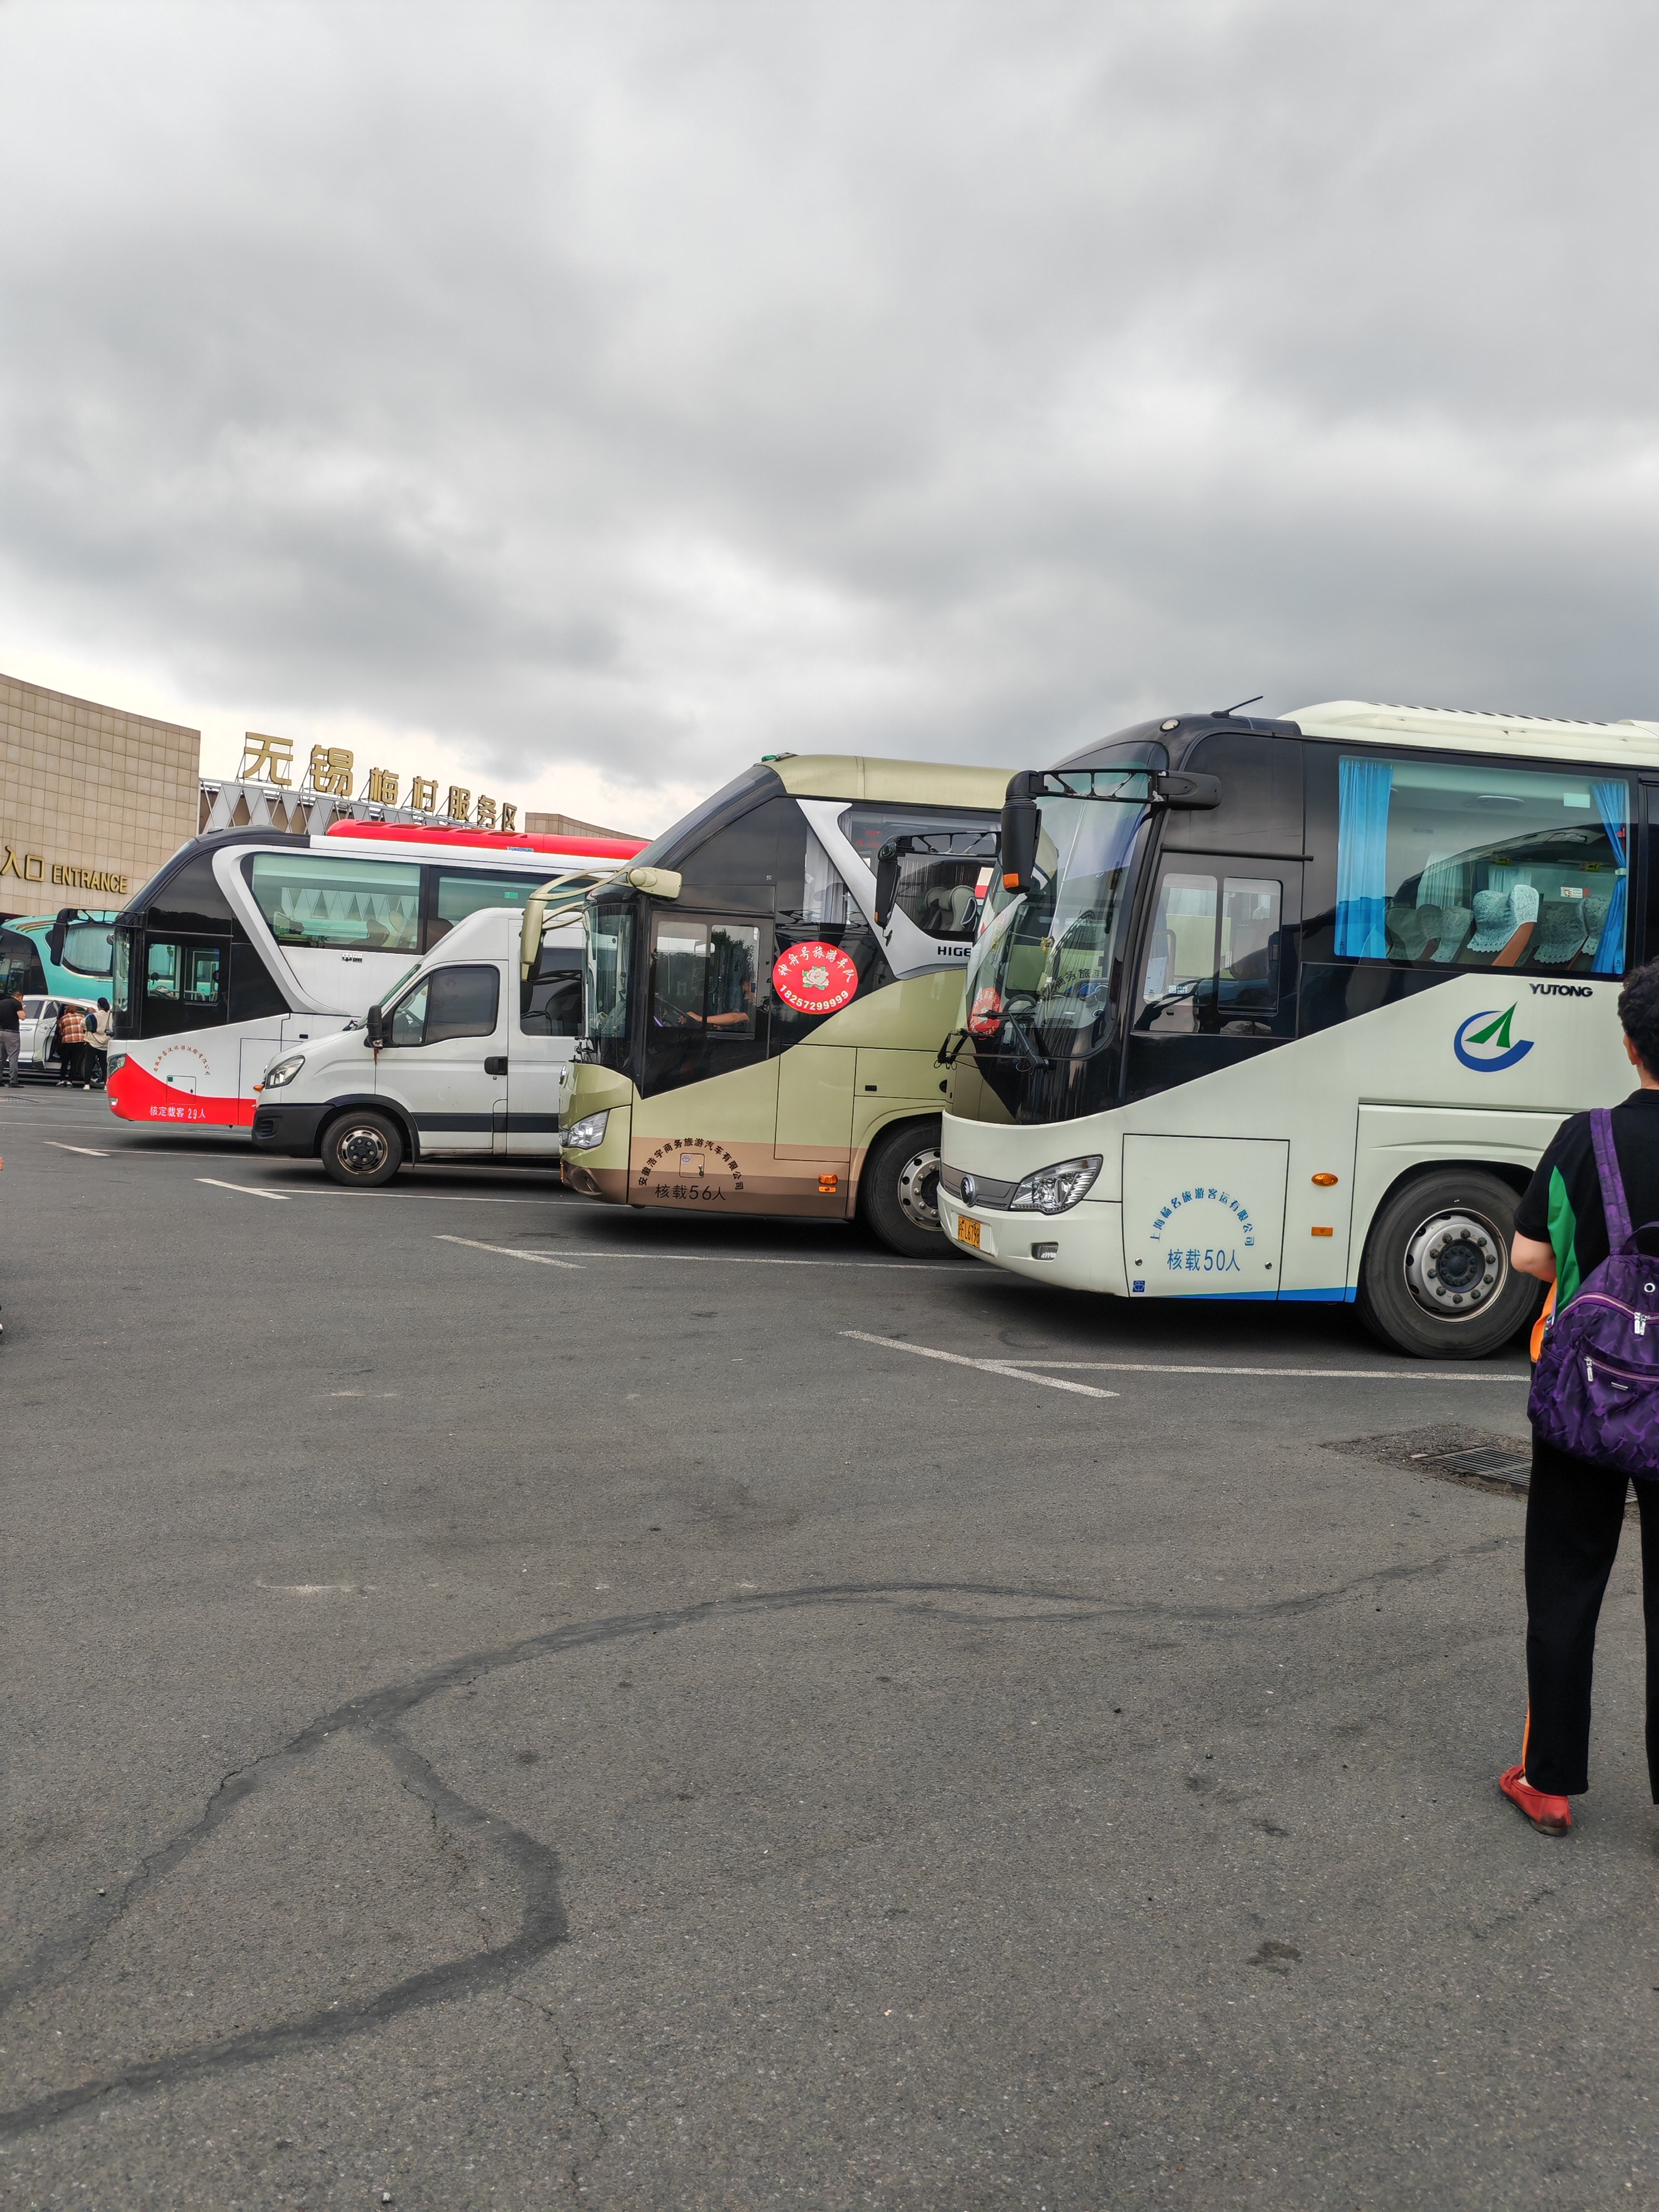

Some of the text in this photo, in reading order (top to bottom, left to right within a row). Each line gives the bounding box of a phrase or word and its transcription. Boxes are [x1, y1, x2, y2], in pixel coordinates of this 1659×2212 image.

[243, 732, 517, 832] 无锡梅村服务区
[1, 846, 44, 882] 入口
[52, 864, 128, 894] ENTRANCE
[938, 946, 972, 957] HIGE
[780, 984, 849, 1010] 18257299999
[1529, 983, 1593, 997] YUTONG
[150, 1105, 206, 1120] 核定载客 29人
[638, 1137, 744, 1190] 安徽浩宇商务旅游汽车有限公司
[655, 1184, 726, 1201] 核载56人
[1166, 1248, 1241, 1272] 核载50人
